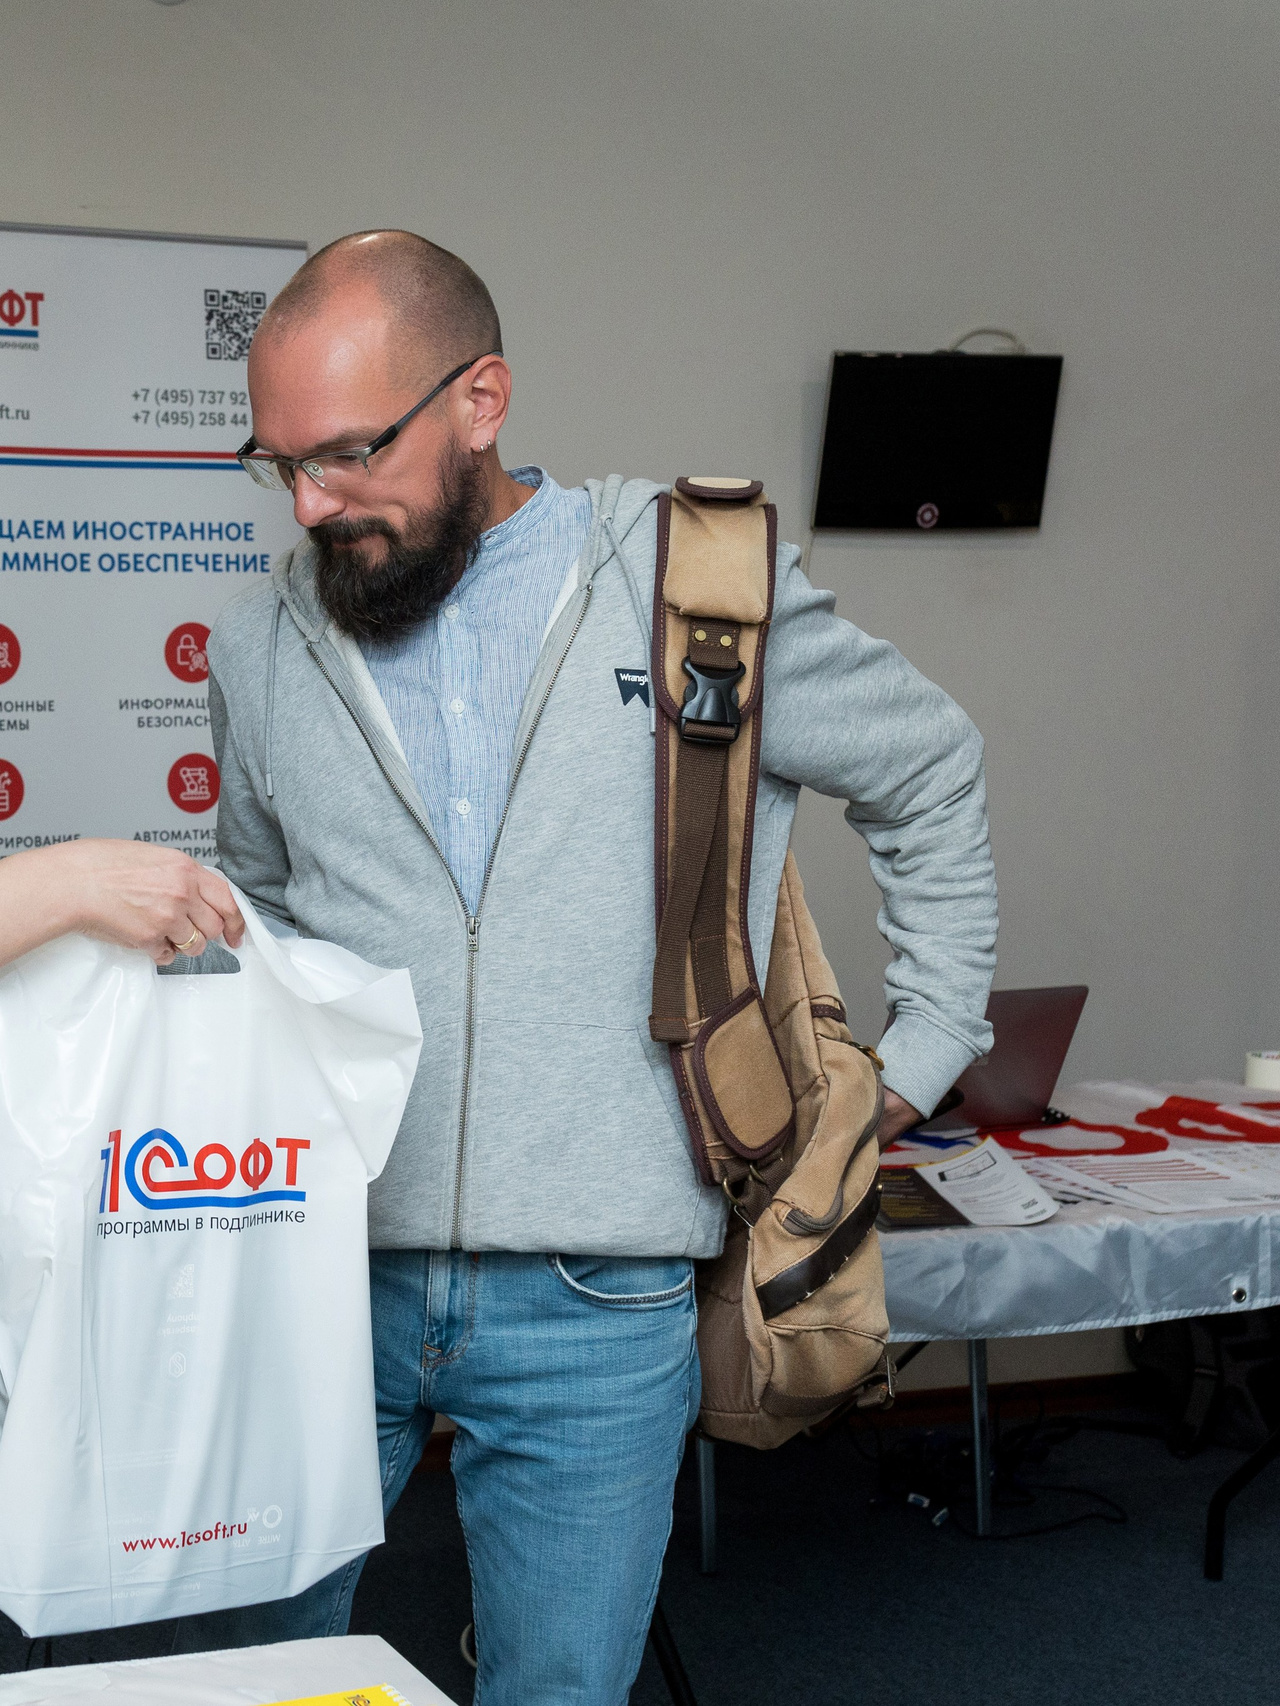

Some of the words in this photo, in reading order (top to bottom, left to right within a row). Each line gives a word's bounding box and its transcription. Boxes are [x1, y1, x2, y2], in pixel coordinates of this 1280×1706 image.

[132, 388, 150, 402] +7
[155, 389, 194, 407] (495)
[198, 390, 225, 405] 737
[229, 391, 247, 406] 92
[133, 410, 150, 425] +7
[155, 411, 195, 429] (495)
[199, 412, 226, 426] 258
[230, 413, 248, 427] 44
[73, 521, 254, 542] ИНОСТРАННОЕ
[98, 553, 270, 574] ОБЕСПЕЧЕНИЕ
[119, 698, 209, 711] ИНФОРМАЦ
[97, 1219, 190, 1239] программы
[195, 1217, 203, 1229] в
[210, 1210, 305, 1233] подлиннике
[122, 1521, 248, 1552] www.1csoft.ru
